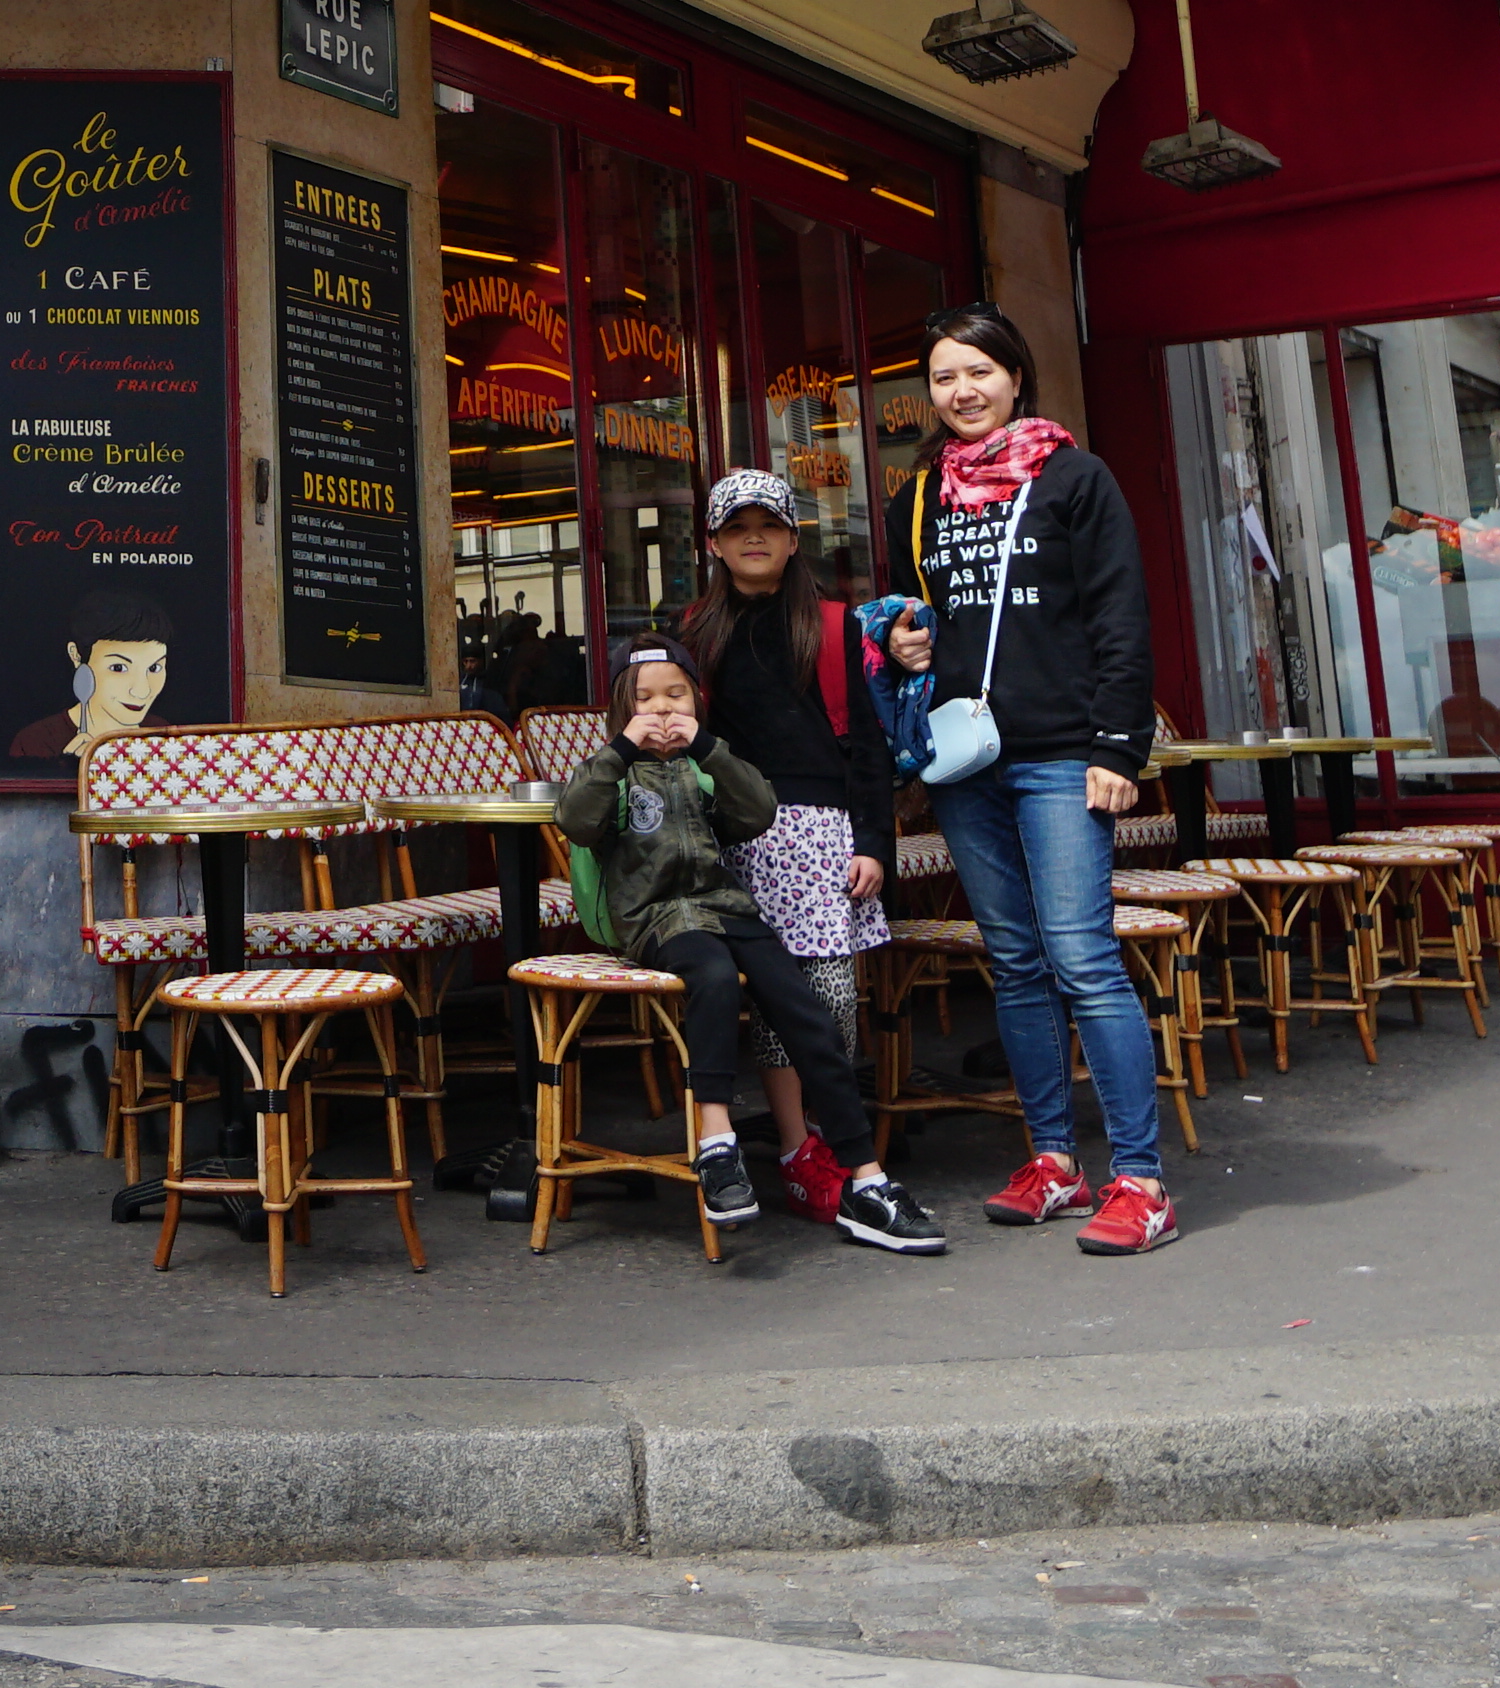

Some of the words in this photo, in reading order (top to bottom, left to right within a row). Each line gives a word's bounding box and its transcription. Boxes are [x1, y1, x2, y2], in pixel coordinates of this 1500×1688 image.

[305, 23, 375, 76] LEPIC
[73, 111, 117, 154] le
[8, 145, 192, 248] Goûter
[37, 269, 47, 289] 1
[65, 266, 151, 291] CAFÉ
[313, 268, 372, 310] PLATS
[29, 309, 36, 324] 1
[47, 308, 122, 325] CHOCOLAT
[127, 308, 200, 325] VIENNOIS
[443, 276, 567, 355] CHAMPAGNE
[10, 349, 48, 371] des
[599, 318, 681, 377] LUNCH
[458, 376, 561, 435] APÉRITIFS
[767, 364, 861, 432] BREAKFAST
[11, 419, 29, 436] LA
[34, 419, 112, 436] FABULEUSE
[604, 407, 695, 462] DINNER
[106, 441, 185, 464] Brûlée
[786, 440, 851, 487] CRÊPES
[68, 471, 182, 495] d'Amélie
[303, 471, 395, 513] DESSERTS
[718, 470, 784, 504] Paris
[9, 520, 61, 546] Ton
[65, 519, 180, 550] Portrait
[92, 552, 113, 564] EN
[120, 552, 194, 565] POLAROID
[922, 549, 952, 575] THE
[950, 568, 975, 588] AS
[983, 564, 1001, 583] IT
[1011, 587, 1040, 604] BE
